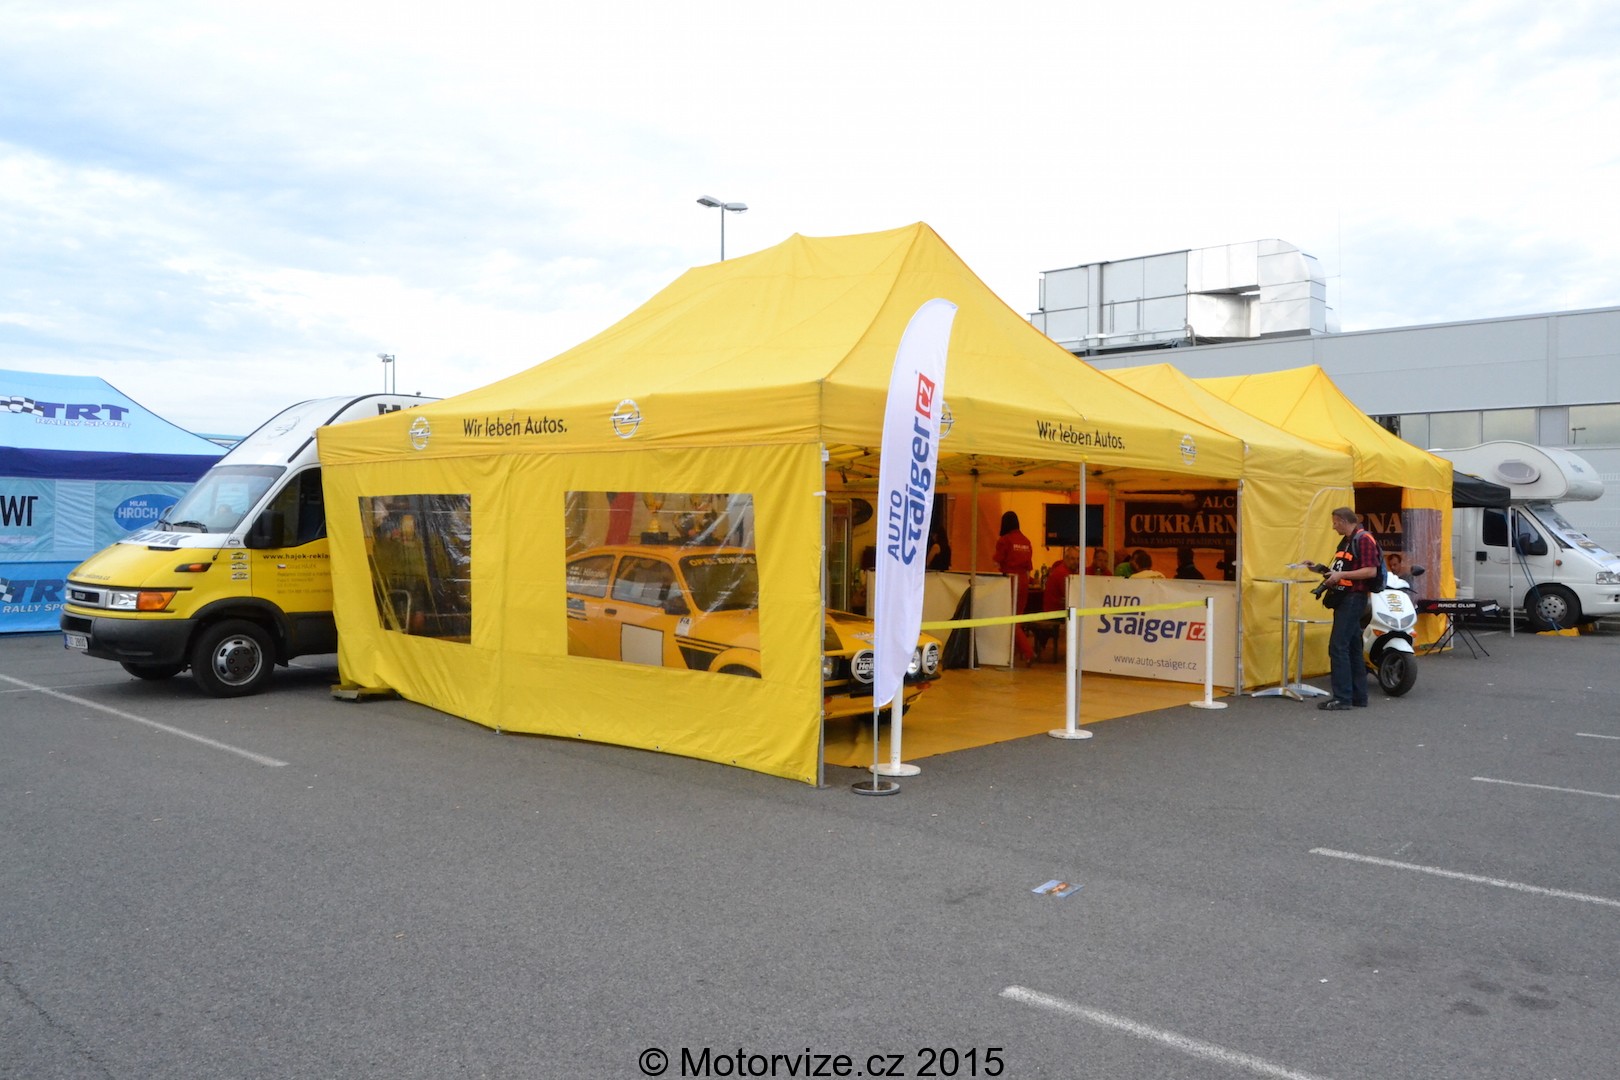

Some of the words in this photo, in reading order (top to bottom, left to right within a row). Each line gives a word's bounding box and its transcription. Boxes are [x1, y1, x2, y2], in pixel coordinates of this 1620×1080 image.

[34, 401, 129, 421] TRT
[36, 418, 81, 427] RALLY
[84, 420, 131, 429] SPORT
[463, 417, 482, 437] Wir
[485, 416, 521, 437] leben
[524, 416, 568, 435] Autos.
[1036, 420, 1057, 441] Wir
[1059, 423, 1092, 446] leben
[1094, 429, 1126, 450] Autos.
[901, 416, 932, 566] Staiger
[1202, 496, 1235, 508] ALC
[118, 507, 158, 519] HROCH
[887, 489, 903, 562] AUTO
[1130, 511, 1237, 534] CUKRÁRN
[263, 553, 331, 561] www.hajek-rekla
[6, 579, 67, 603] TR
[2, 604, 41, 613] RALLY
[1102, 595, 1141, 607] AUTO
[1097, 611, 1187, 643] Staiger
[858, 662, 874, 670] Hell
[1113, 655, 1197, 671] www.auto-staiger.cz
